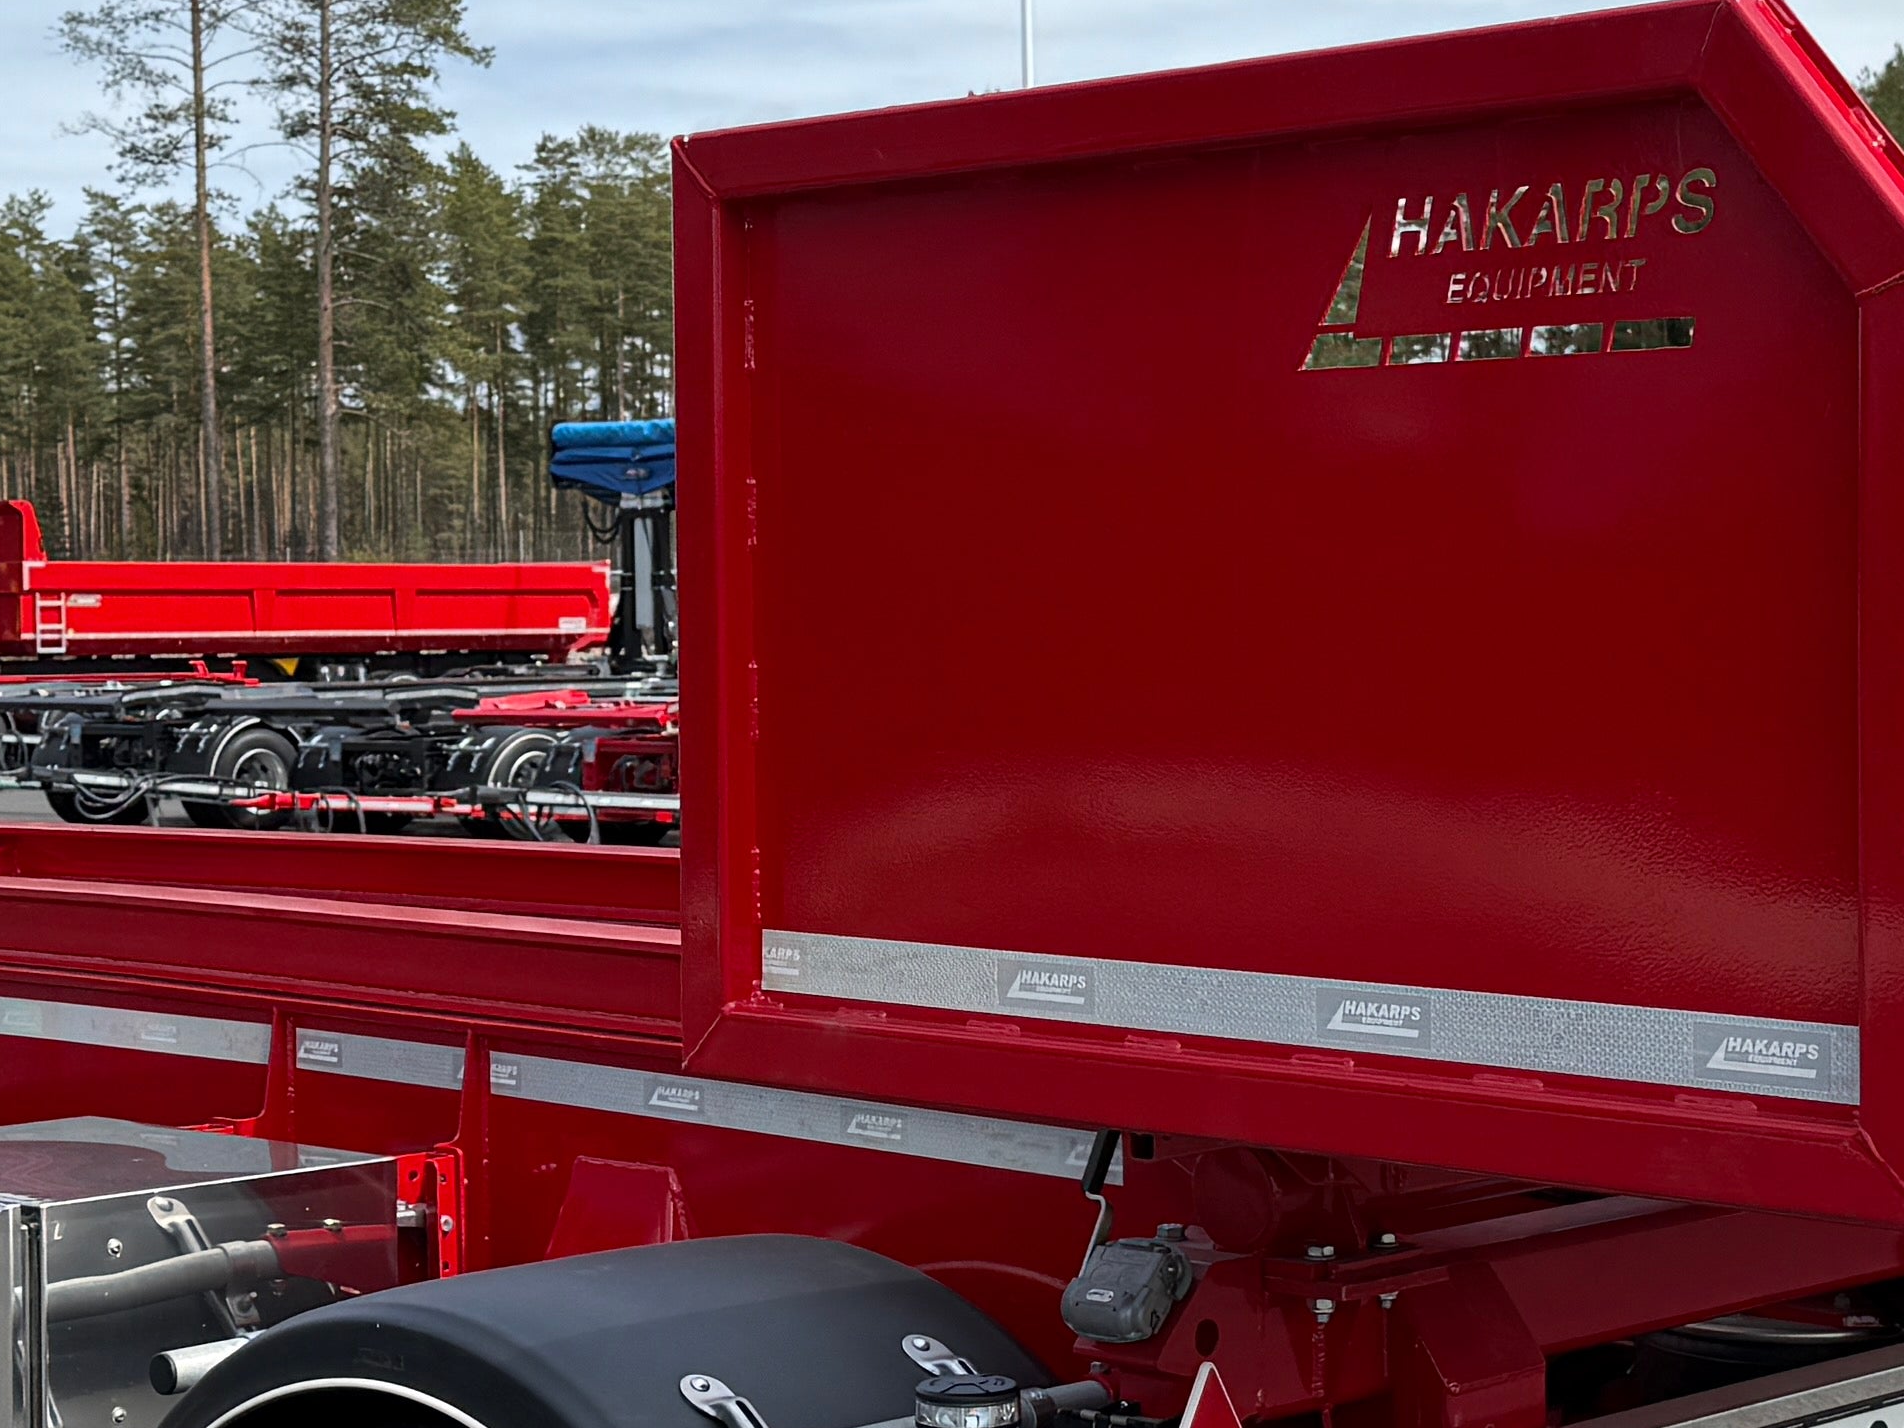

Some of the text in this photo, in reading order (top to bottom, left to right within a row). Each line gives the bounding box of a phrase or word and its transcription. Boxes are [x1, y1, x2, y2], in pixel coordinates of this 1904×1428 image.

[1387, 168, 1717, 258] HAKARPS
[1446, 259, 1647, 304] EQUIPMENT
[1022, 969, 1086, 989] HAKARPS
[1344, 999, 1421, 1021] HAKARPS
[1727, 1036, 1819, 1060] HAKARPS
